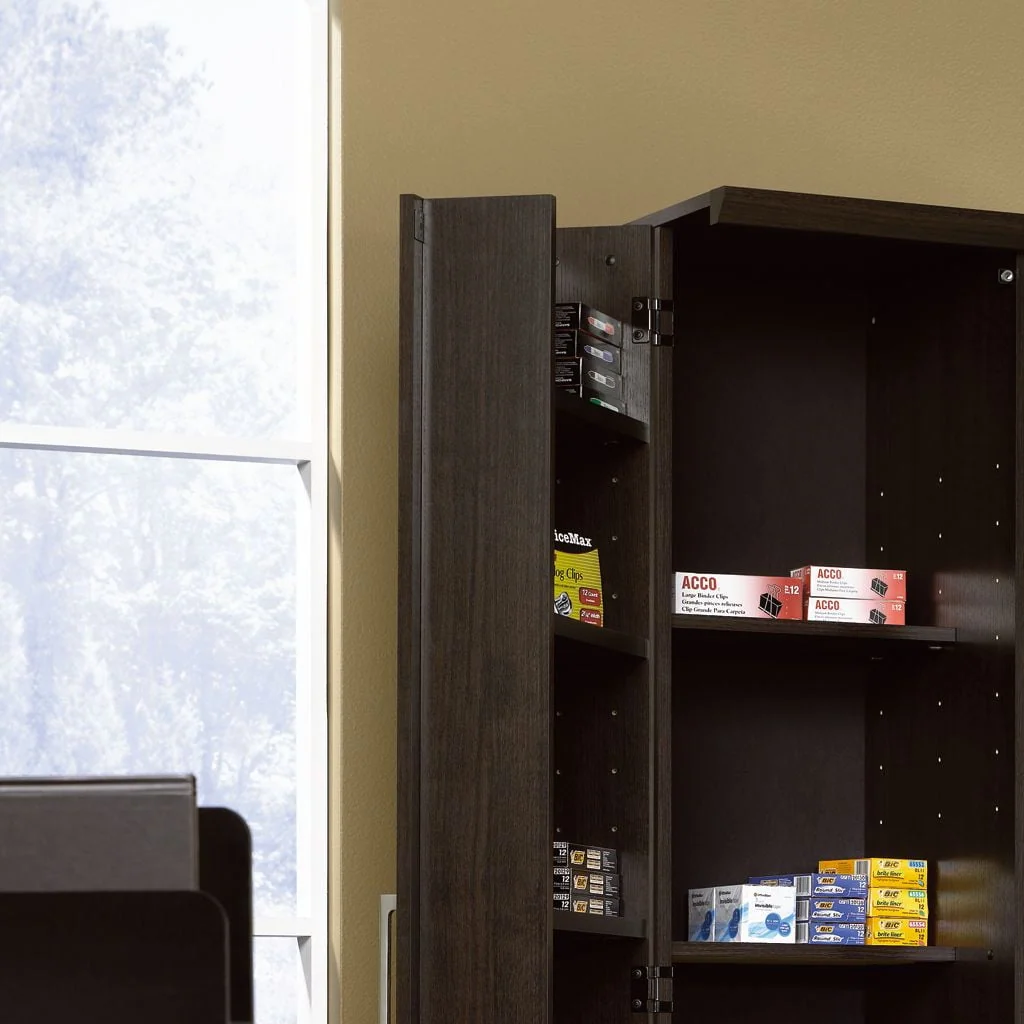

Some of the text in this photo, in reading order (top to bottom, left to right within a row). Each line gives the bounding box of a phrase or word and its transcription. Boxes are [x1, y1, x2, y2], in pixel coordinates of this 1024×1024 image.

[566, 567, 583, 583] Clips
[818, 568, 842, 580] ACCO
[682, 575, 717, 591] ACCO
[790, 586, 800, 594] 12
[815, 600, 840, 611] ACCO
[562, 875, 570, 883] 12
